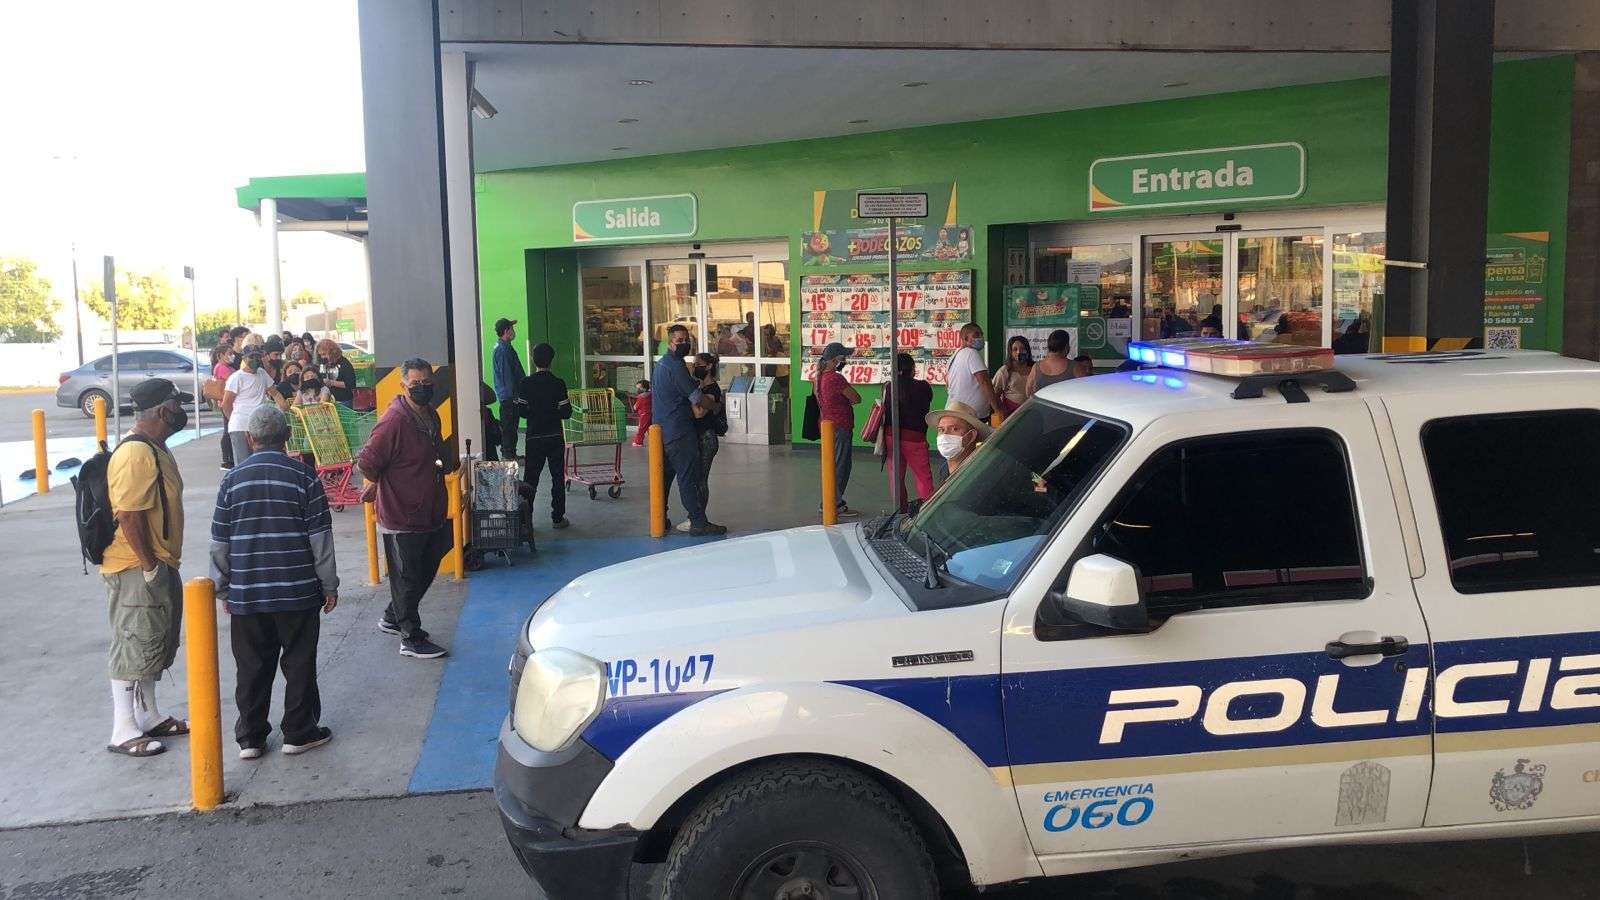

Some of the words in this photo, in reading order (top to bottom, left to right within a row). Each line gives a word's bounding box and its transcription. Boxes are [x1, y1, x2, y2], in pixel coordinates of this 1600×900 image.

[1132, 160, 1254, 194] Entrada
[604, 206, 661, 229] Salida
[1043, 782, 1154, 803] EMERGENCIA
[1043, 796, 1154, 832] 060
